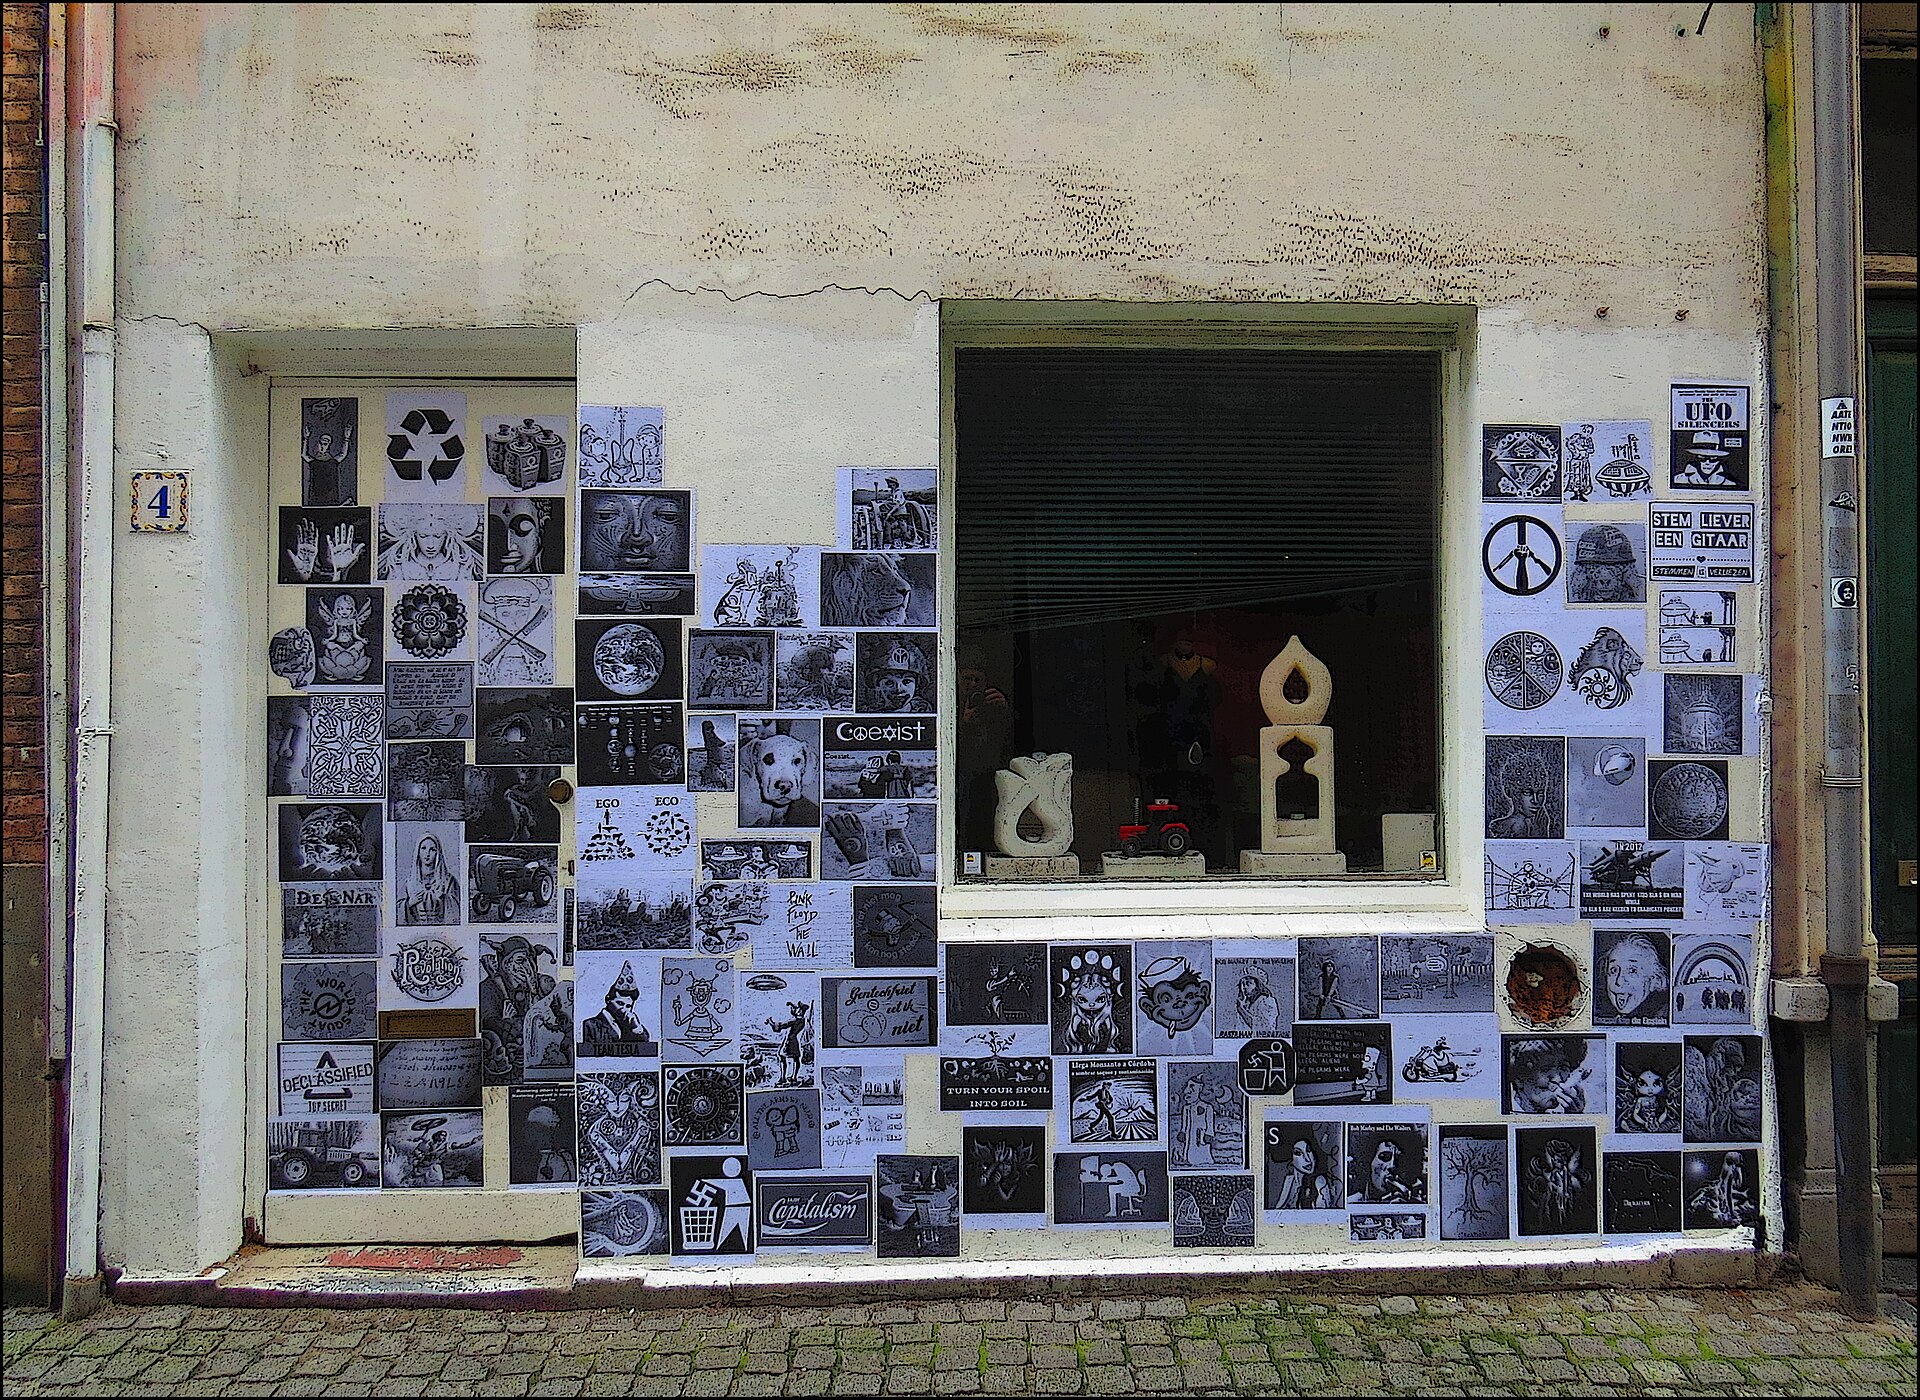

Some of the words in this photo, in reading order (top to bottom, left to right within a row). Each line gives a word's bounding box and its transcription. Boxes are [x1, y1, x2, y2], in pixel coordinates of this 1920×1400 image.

[1685, 402, 1732, 421] UFO
[147, 485, 172, 518] 4
[1653, 513, 1691, 527] STEM
[1701, 514, 1750, 528] LIEVER
[1656, 532, 1682, 546] EEN
[1692, 533, 1747, 547] GITAAR
[1654, 567, 1694, 575] STEMMEN
[595, 799, 620, 808] EGO
[655, 797, 679, 806] ECO
[1625, 842, 1643, 851] 2012
[787, 890, 813, 907] PINK
[787, 905, 818, 925] FLOYD
[789, 923, 812, 940] THE
[786, 940, 819, 958] WALL
[300, 987, 313, 1014] THE
[316, 978, 356, 1005] WORLD
[891, 1015, 924, 1036] niet
[283, 1062, 373, 1093] DECLASSIFIED
[947, 1087, 979, 1095] TURN
[1016, 1086, 1050, 1094] SPOIL
[308, 1101, 321, 1113] TOP
[322, 1100, 347, 1112] SECRET
[970, 1100, 998, 1108] INTO
[1269, 1127, 1279, 1145] S
[768, 1190, 859, 1229] Capitalism
